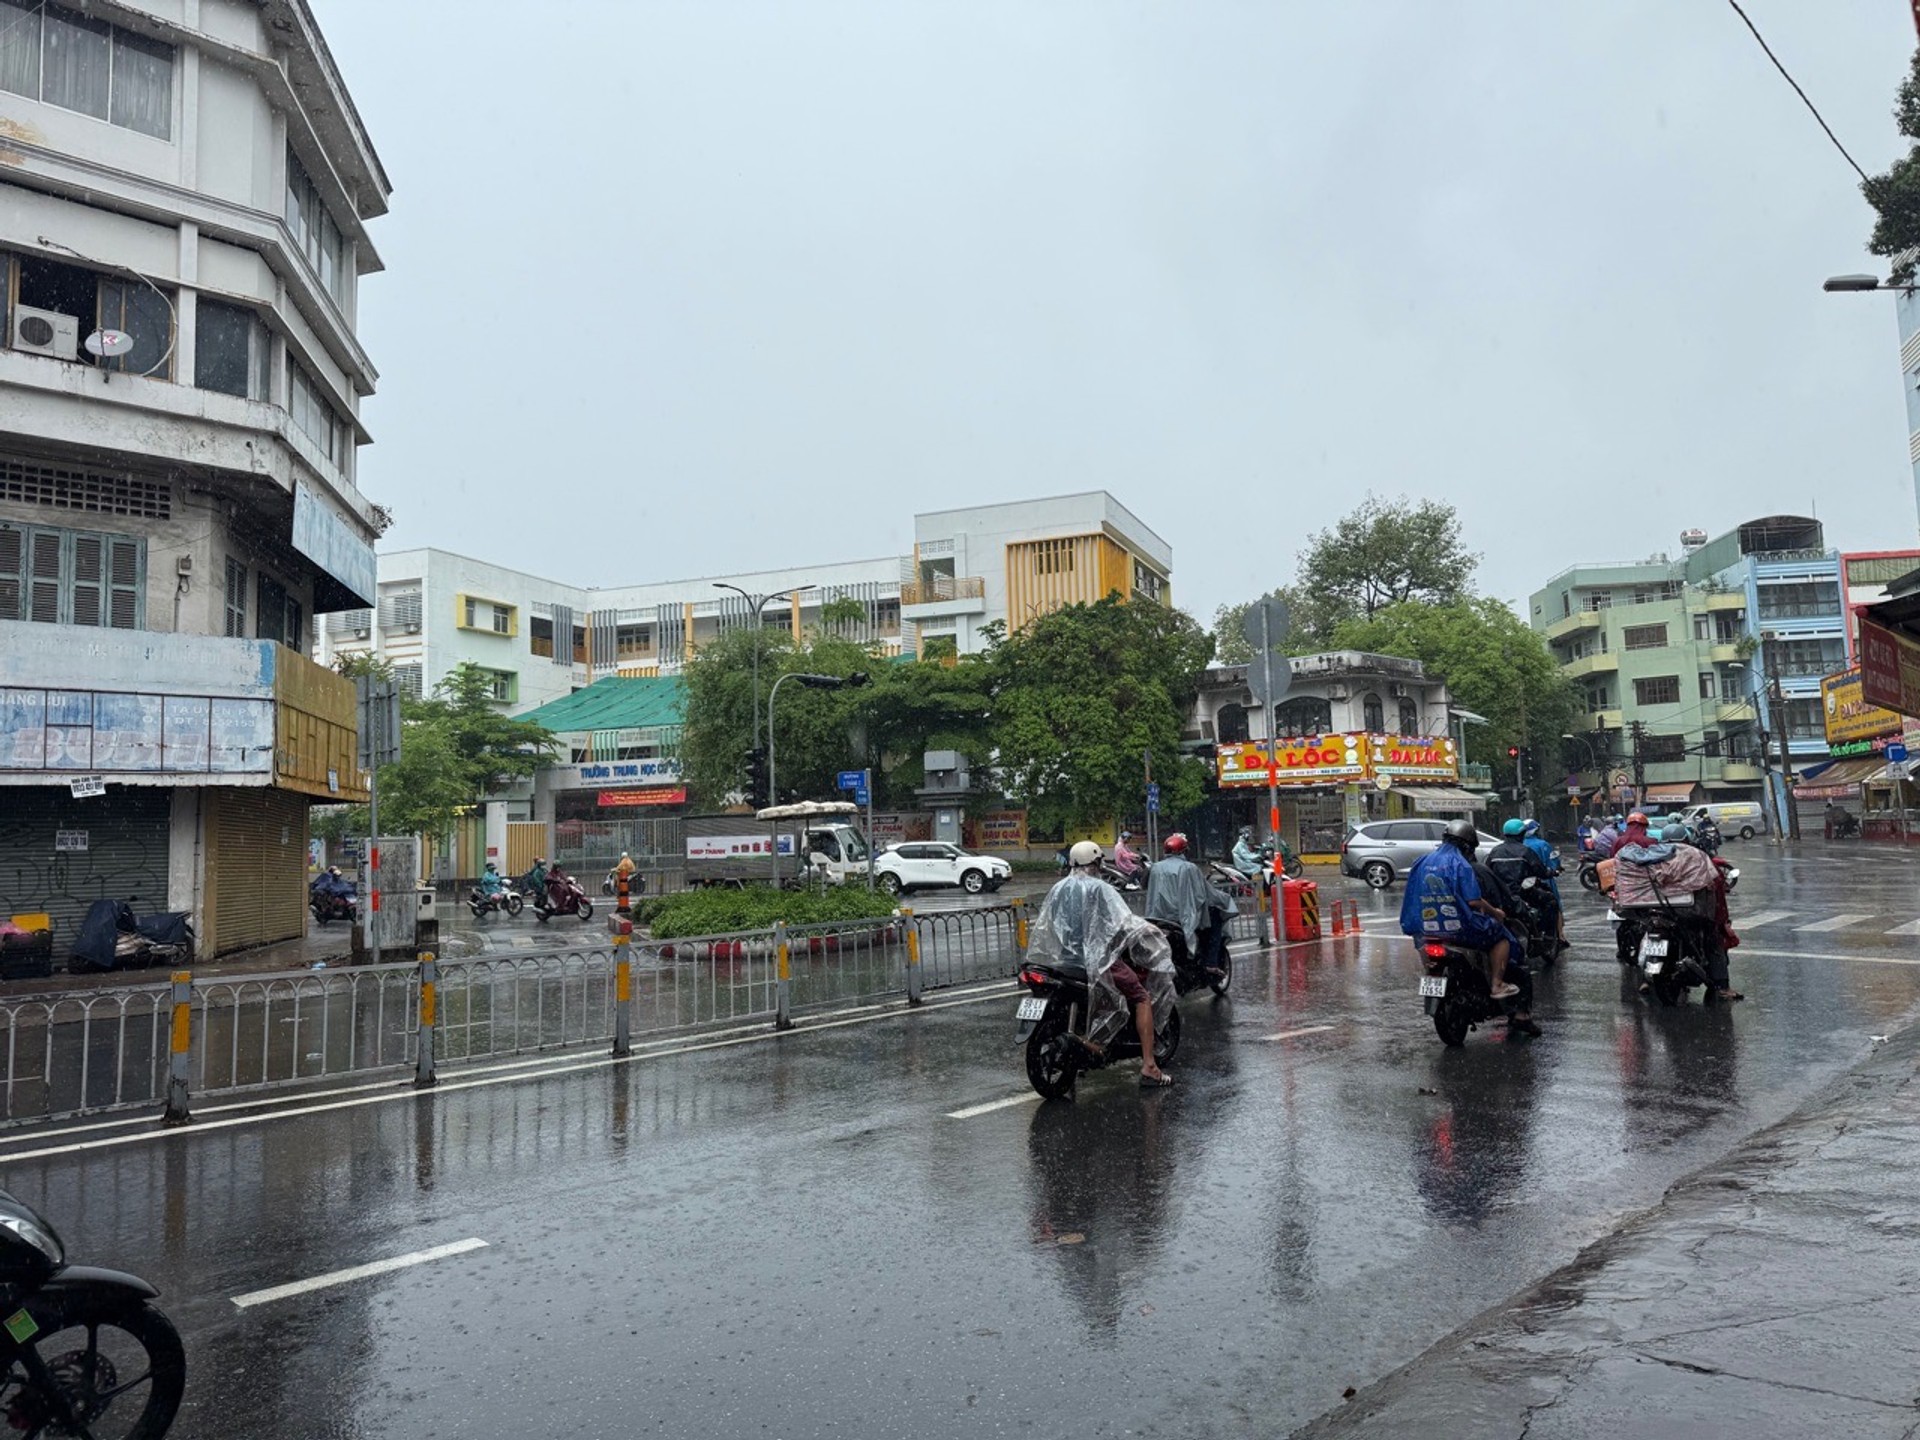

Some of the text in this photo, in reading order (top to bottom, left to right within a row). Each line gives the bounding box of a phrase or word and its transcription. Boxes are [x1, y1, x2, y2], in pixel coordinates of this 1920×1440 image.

[1287, 747, 1340, 768] LỘC
[612, 765, 639, 776] TRUNG
[641, 763, 656, 777] HỌC
